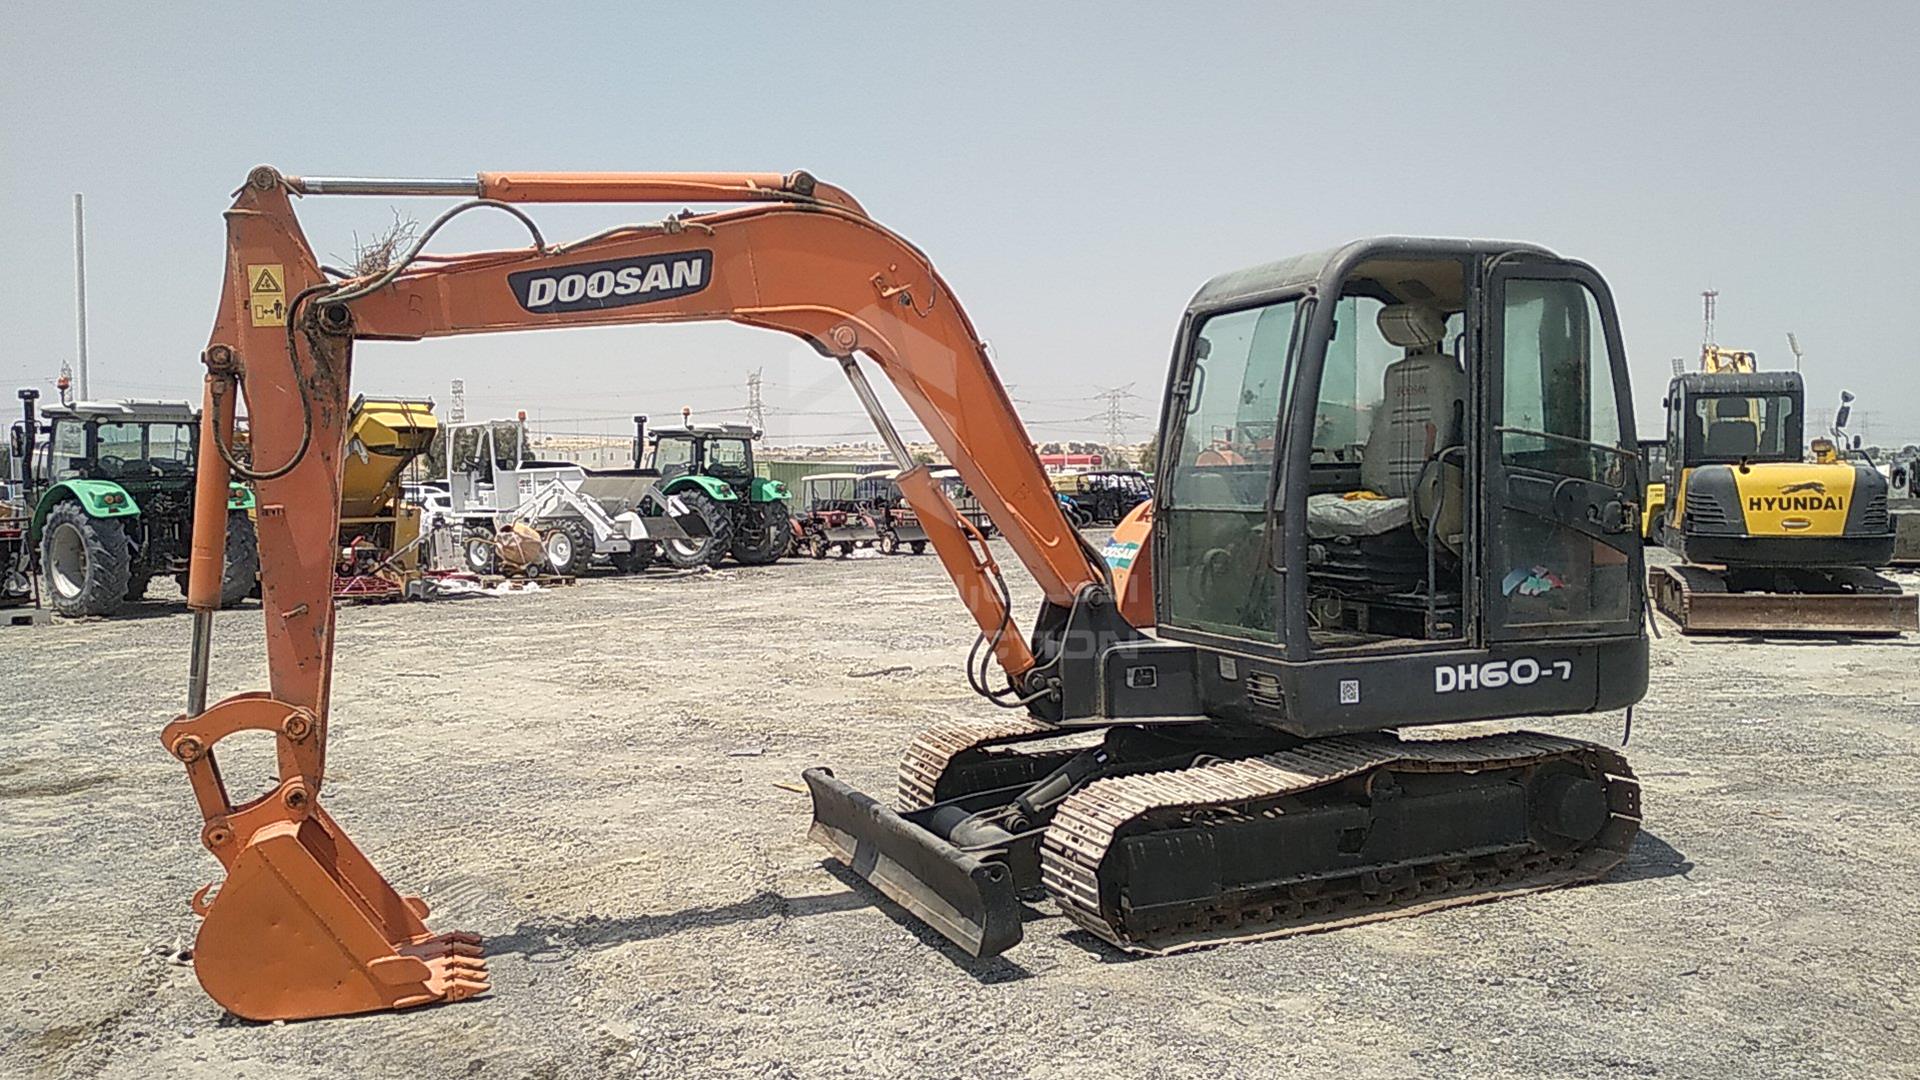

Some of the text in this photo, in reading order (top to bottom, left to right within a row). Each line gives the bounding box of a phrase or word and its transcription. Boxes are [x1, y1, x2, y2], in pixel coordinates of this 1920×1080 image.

[527, 258, 703, 308] DOOSAN
[1749, 496, 1844, 512] HYUNDAI
[1435, 658, 1572, 693] DH60-7
